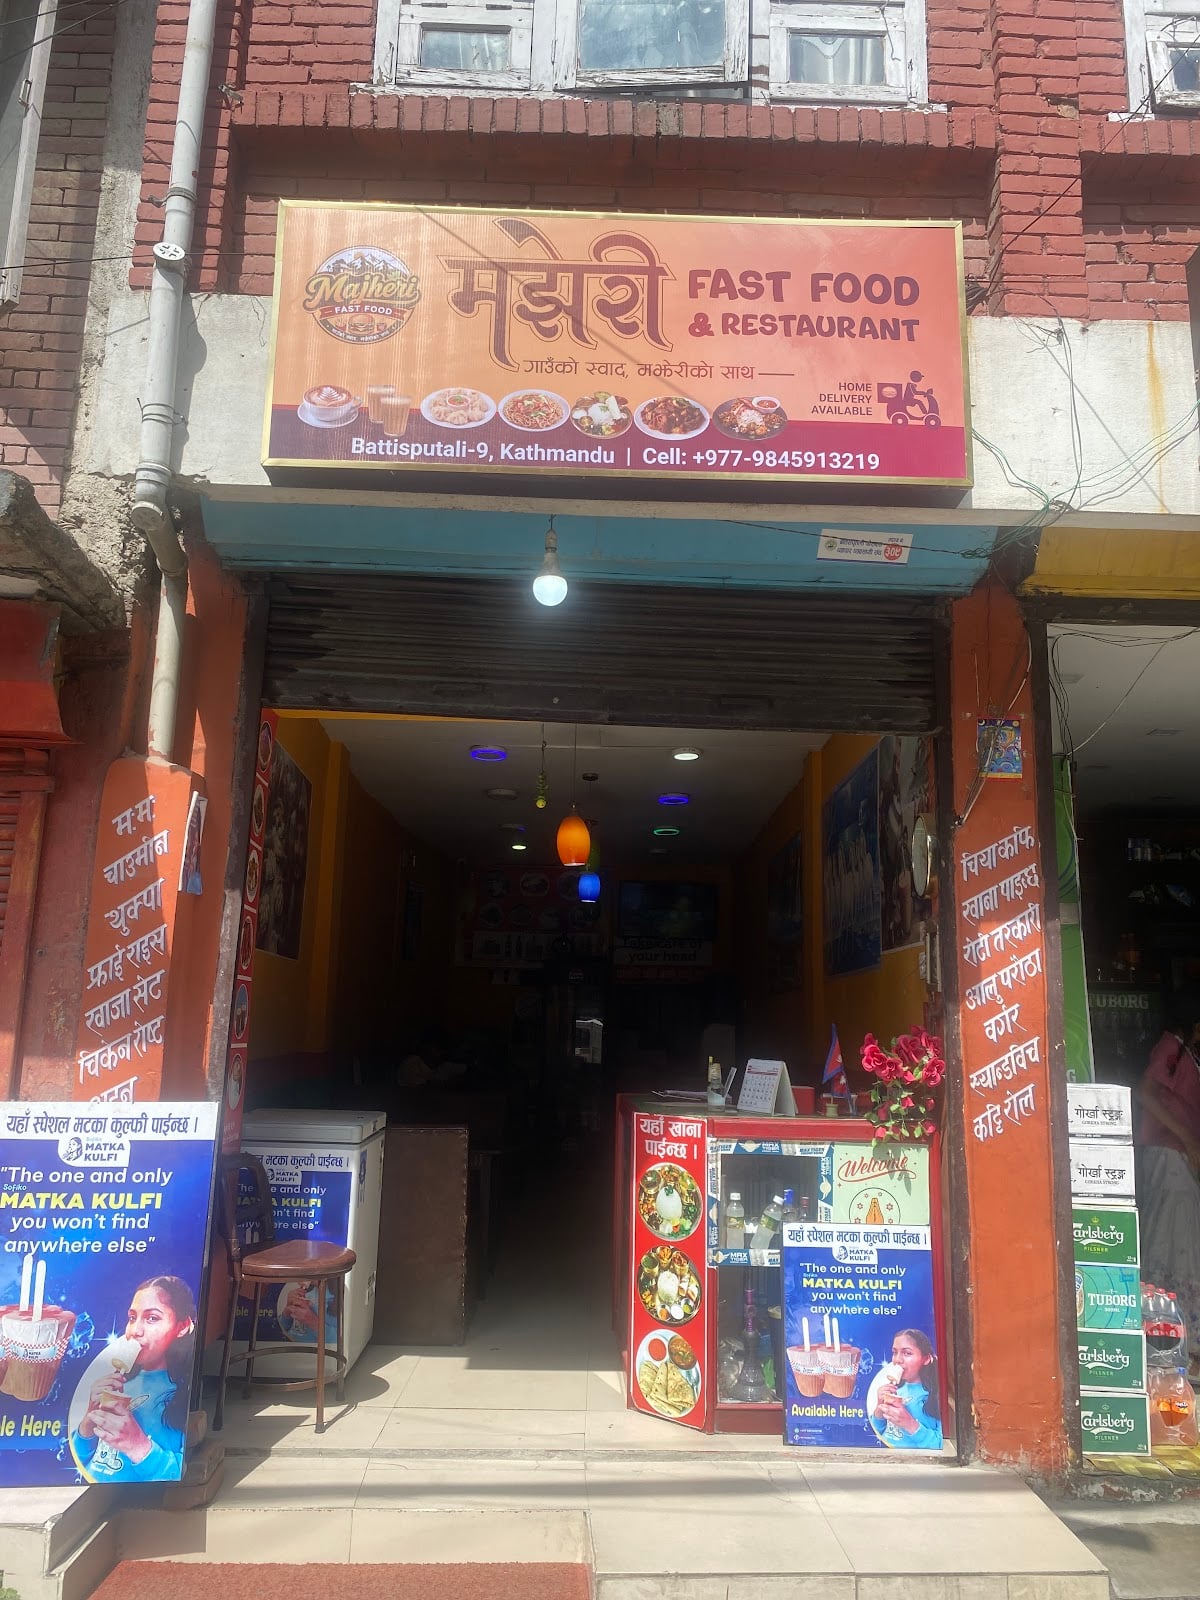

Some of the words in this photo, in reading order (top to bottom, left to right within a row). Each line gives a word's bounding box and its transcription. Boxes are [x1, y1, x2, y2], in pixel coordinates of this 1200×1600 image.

[304, 274, 420, 311] Majheri
[688, 268, 791, 302] FAST
[810, 272, 920, 306] FOOD
[334, 305, 361, 314] FAST
[364, 305, 392, 315] FOOD
[688, 312, 715, 337] &
[721, 312, 920, 342] RESTAURANT
[523, 357, 578, 376] गाउँको
[586, 361, 630, 379] स्वाद,
[721, 366, 756, 381] साथ
[838, 383, 872, 392] HOME
[819, 393, 872, 404] DELIVERY
[811, 405, 873, 416] AVAILABLE
[351, 437, 494, 462] Battisputali-9,
[500, 442, 616, 464] Kathmandu
[642, 447, 687, 466] Cell:
[692, 450, 880, 471] +977-9845913219
[960, 852, 999, 882] चिया
[962, 885, 999, 927] खाना
[990, 902, 1041, 952] तरकारी
[85, 988, 132, 1036] खाजा
[133, 969, 166, 1013] सेट
[1074, 1104, 1100, 1119] गोर्खा
[6, 1108, 30, 1134] यहाँ
[32, 1111, 71, 1134] स्पेशल
[73, 1116, 109, 1134] मटका
[110, 1112, 149, 1138] कुल्फी
[151, 1113, 190, 1136] पाईन्छ
[640, 1113, 665, 1136] यहाँ
[668, 1120, 702, 1138] खाना
[85, 1143, 125, 1151] MATKA
[645, 1137, 688, 1159] पाईन्छ
[84, 1153, 117, 1161] KULFI
[266, 1155, 289, 1167] मटका
[840, 1156, 912, 1181] Welcome
[1078, 1163, 1102, 1178] गोर्खा
[49, 1170, 84, 1183] one
[90, 1168, 127, 1184] and
[132, 1168, 173, 1186] only
[3, 1183, 27, 1191] Sofiko
[280, 1185, 301, 1194] and
[303, 1186, 326, 1195] only
[0, 1193, 84, 1209] MATKA
[91, 1193, 163, 1209] KULFI
[281, 1198, 322, 1207] KULFI
[293, 1209, 315, 1218] find
[10, 1216, 46, 1232] you
[52, 1214, 107, 1229] won't
[112, 1213, 150, 1229] find
[788, 1225, 804, 1242] यहाँ
[807, 1227, 833, 1243] स्पेशल
[836, 1231, 860, 1243] मटका
[863, 1229, 890, 1246] कुल्फी
[892, 1229, 921, 1246] पाईन्छ
[4, 1237, 102, 1254] anywhere
[108, 1237, 156, 1253] else"
[830, 1265, 852, 1273] one
[855, 1265, 877, 1274] and
[881, 1265, 906, 1276] only
[802, 1278, 855, 1289] MATKA
[859, 1280, 902, 1290] KULFI
[812, 1293, 833, 1301] you
[837, 1291, 869, 1301] won't
[873, 1291, 896, 1301] find
[1088, 1293, 1136, 1307] TUBORG
[810, 1305, 870, 1315] anywhere
[792, 1404, 836, 1417] Available
[840, 1406, 863, 1417] Here
[20, 1415, 61, 1436] Here
[1081, 1411, 1134, 1431] Carlsberg
